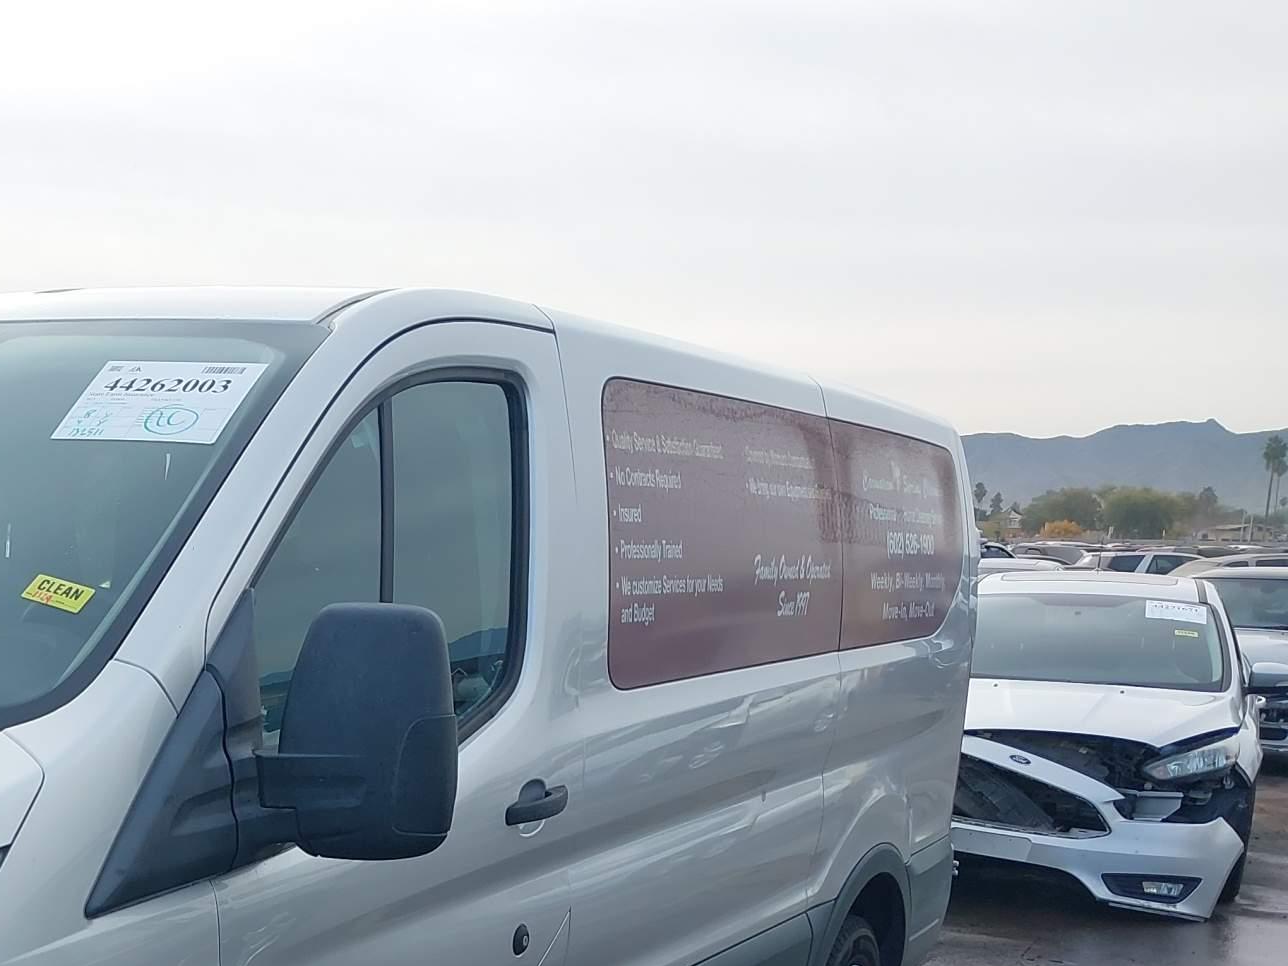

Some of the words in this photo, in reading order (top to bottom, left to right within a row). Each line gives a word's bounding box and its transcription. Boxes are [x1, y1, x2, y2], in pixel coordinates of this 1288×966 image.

[103, 377, 233, 394] 44262003
[615, 466, 626, 486] No
[626, 467, 655, 487] Contracts
[655, 469, 682, 493] Required
[618, 504, 642, 522] Insured
[620, 539, 662, 563] Professionally
[662, 539, 683, 559] Trained
[887, 531, 904, 560] (602)
[905, 533, 935, 555] 526-1900
[754, 554, 778, 587] Family
[778, 554, 799, 580] Owned
[37, 579, 85, 601] CLEAN
[621, 576, 632, 596] We
[632, 576, 662, 595] customize
[662, 575, 686, 594] Services
[686, 574, 694, 593] for
[694, 579, 707, 598] your
[707, 574, 724, 593] Needs
[621, 603, 633, 623] and
[633, 603, 655, 626] Budget
[777, 591, 795, 617] Since
[795, 591, 810, 617] 1997
